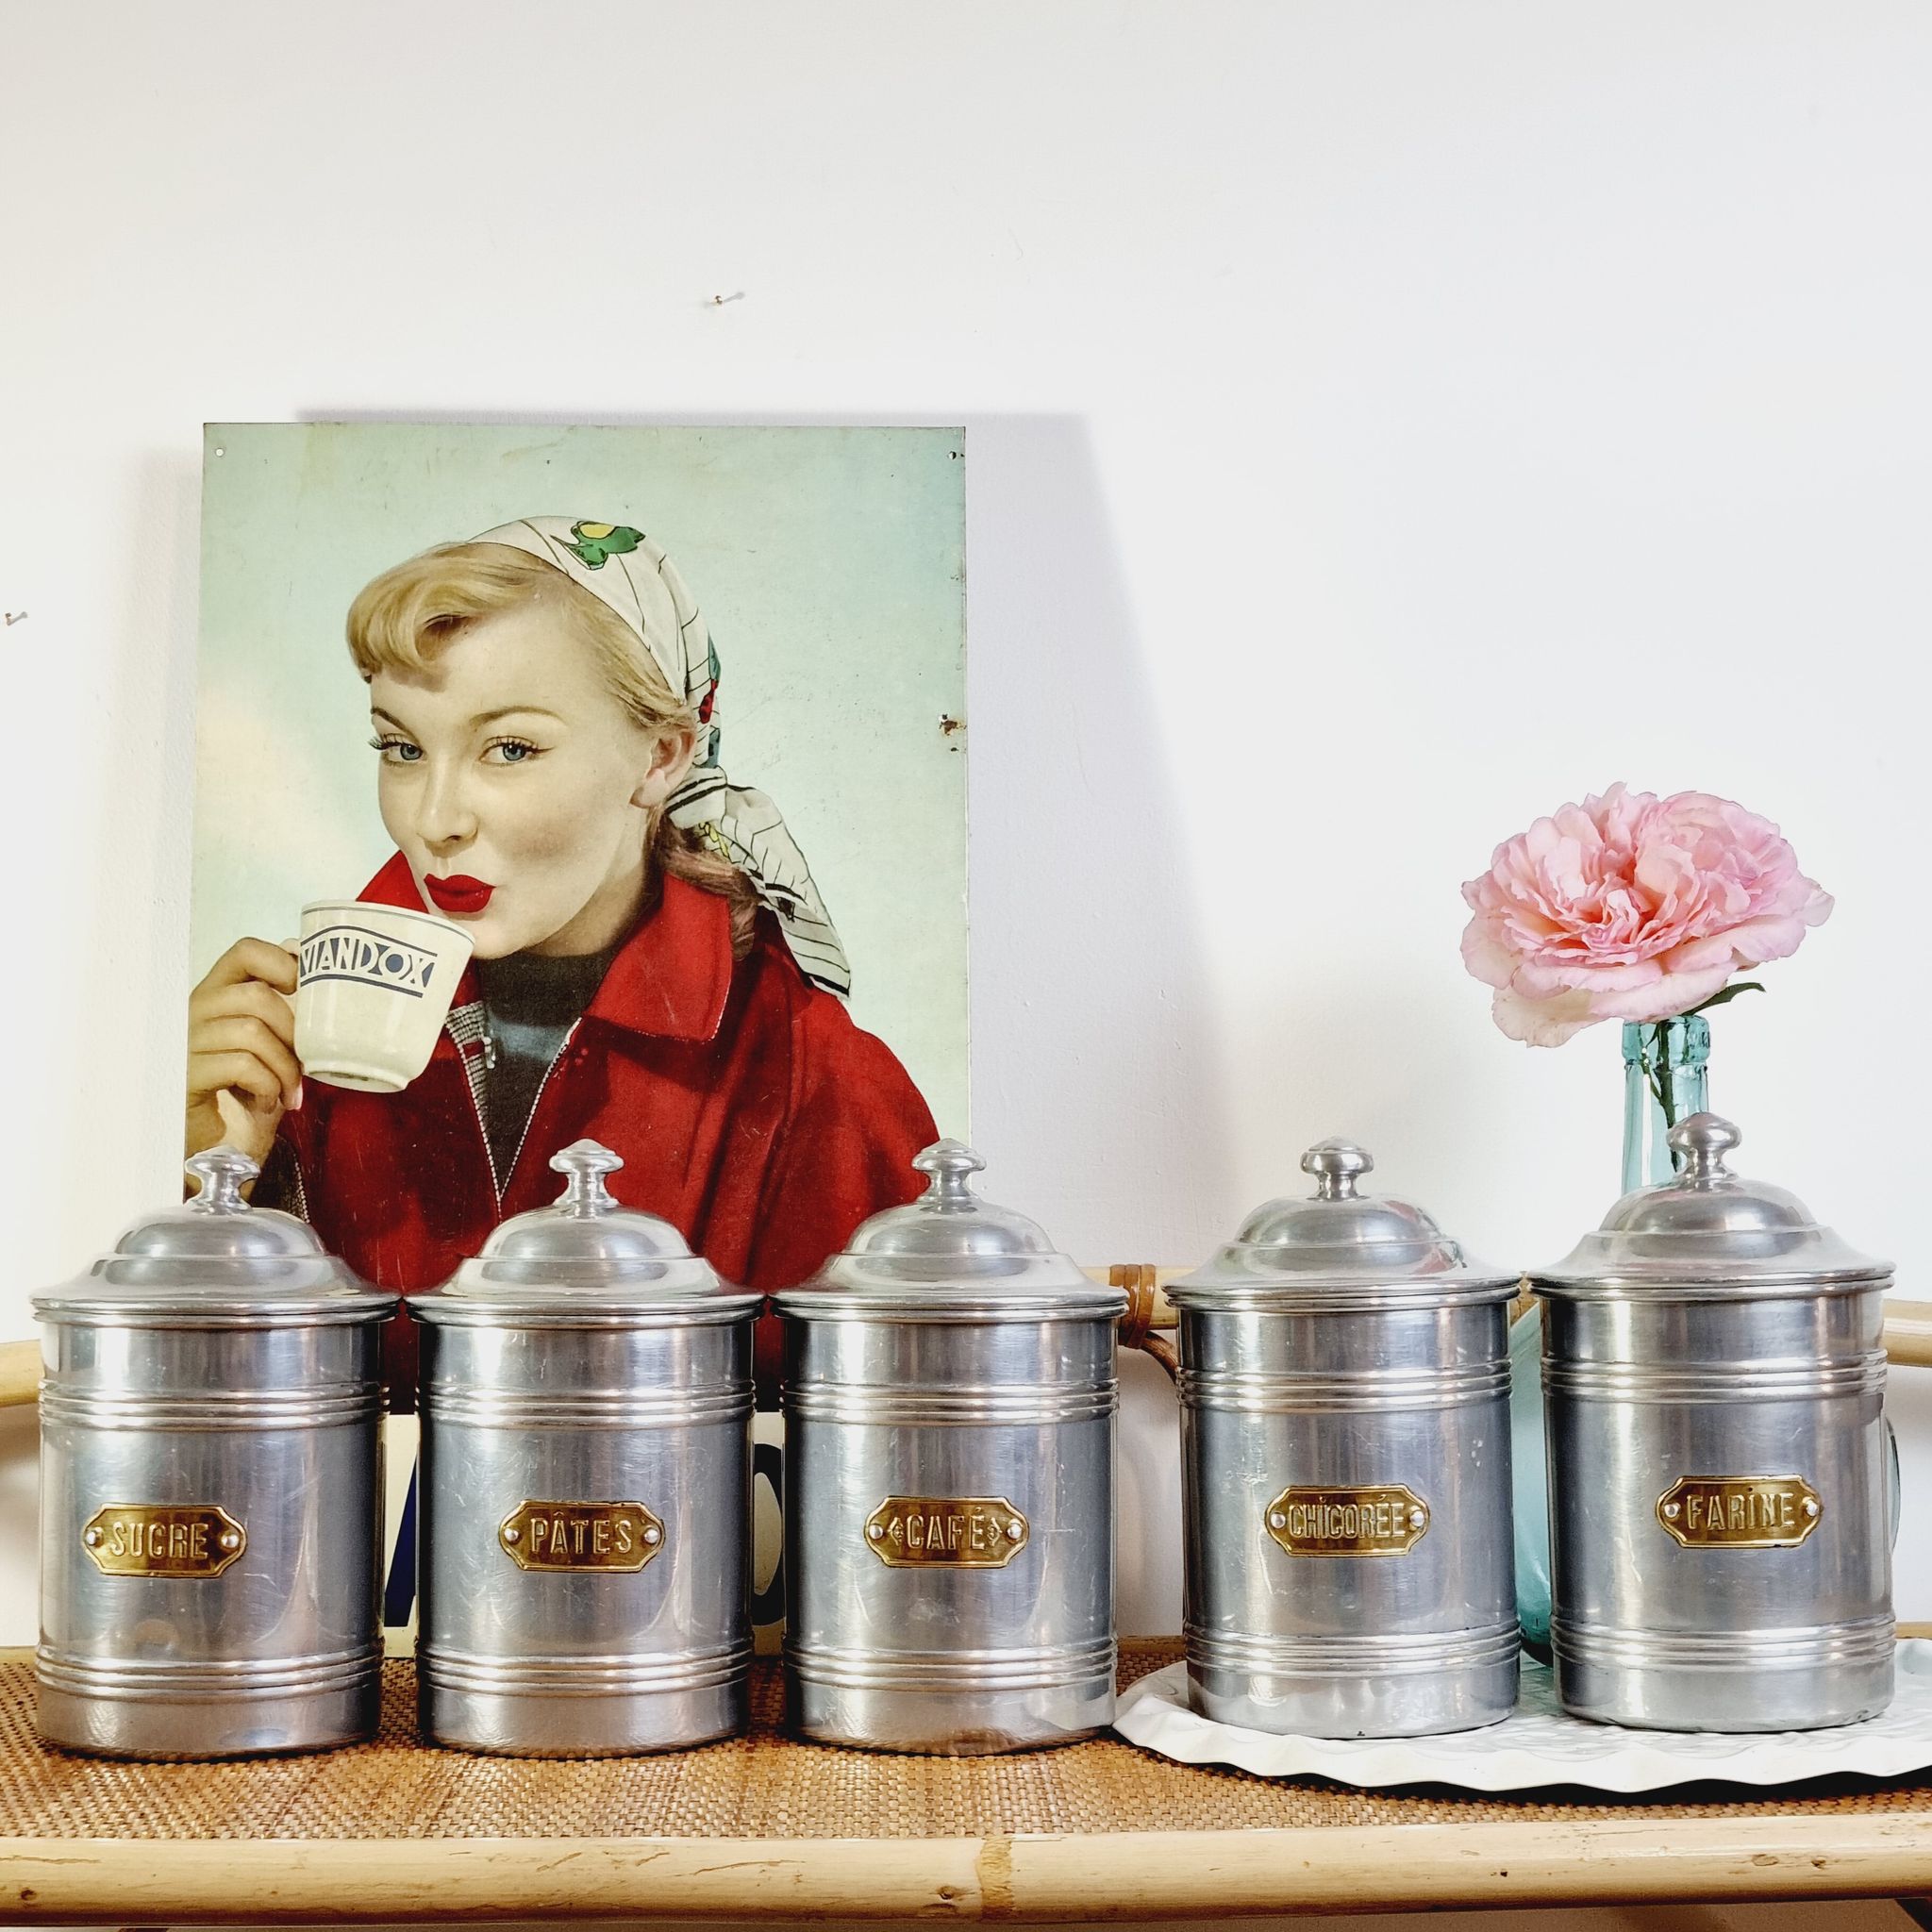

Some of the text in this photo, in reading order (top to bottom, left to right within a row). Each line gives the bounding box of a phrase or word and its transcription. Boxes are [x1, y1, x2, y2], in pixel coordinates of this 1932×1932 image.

[300, 937, 435, 989] VIANDOX
[906, 1507, 985, 1550] CAFÉ
[1686, 1486, 1795, 1530] FARINE
[109, 1521, 209, 1558] SUCRE
[530, 1511, 632, 1555] PÂTES
